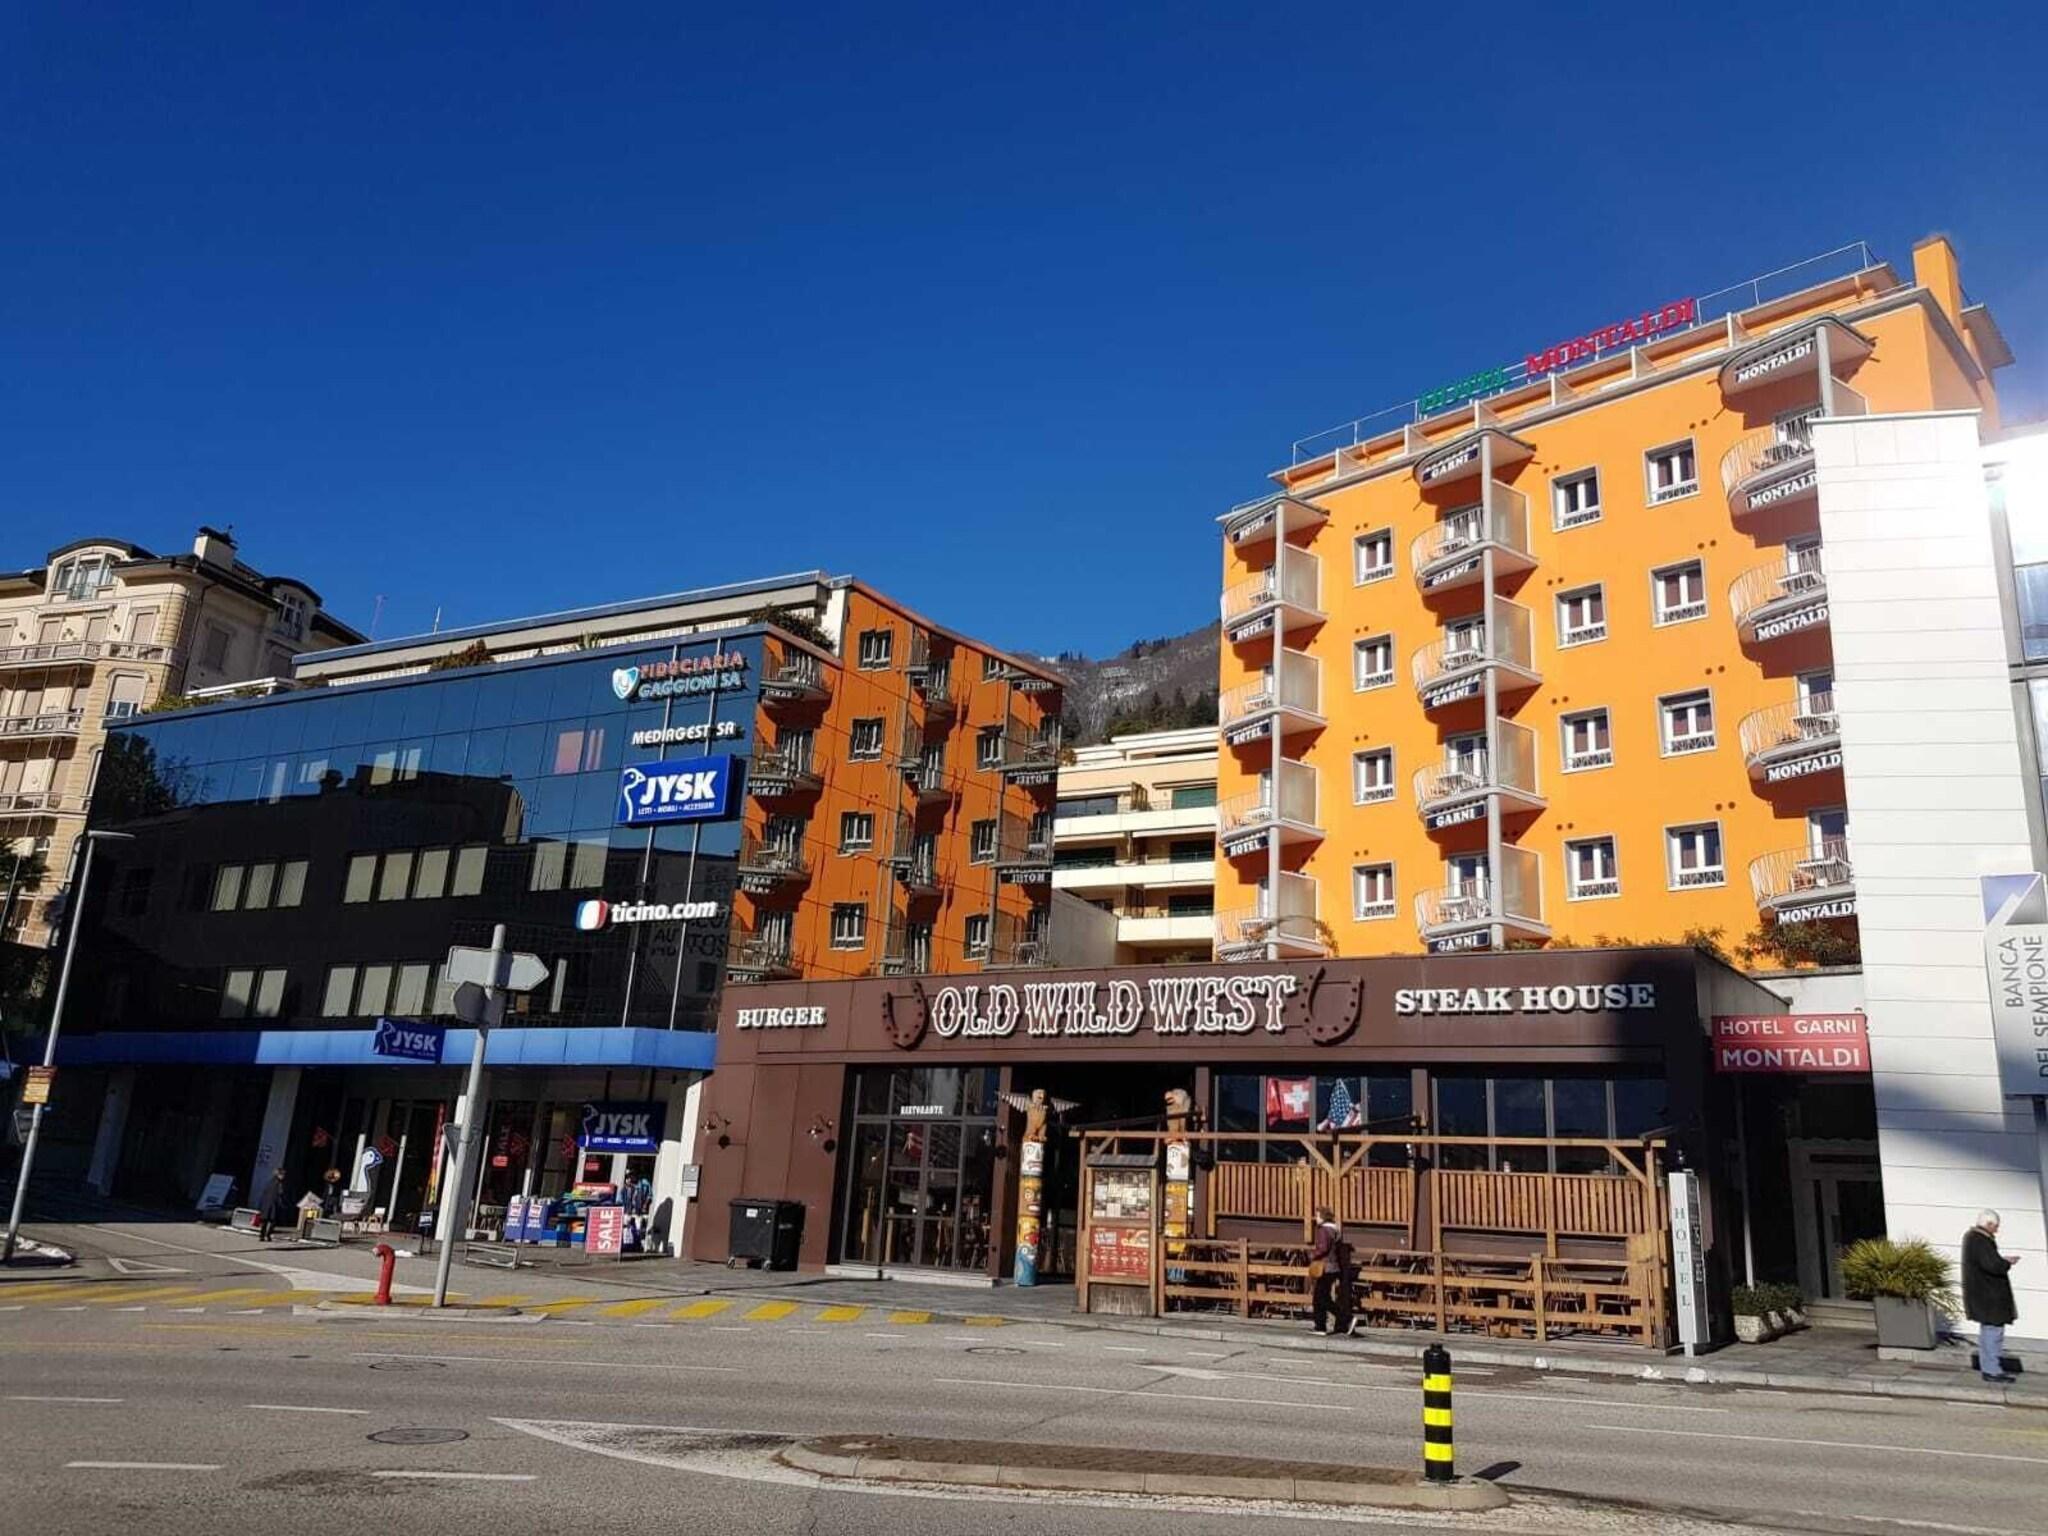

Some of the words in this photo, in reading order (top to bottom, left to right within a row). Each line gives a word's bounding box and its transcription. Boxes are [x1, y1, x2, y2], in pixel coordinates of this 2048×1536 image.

[1525, 297, 1695, 377] MONTALDI
[1738, 342, 1812, 383] MONTALDI
[1430, 453, 1469, 479] GARNI
[1750, 472, 1817, 509] MONTALD
[1239, 517, 1266, 538] HOTEL
[1432, 562, 1470, 586] GARNI
[1237, 620, 1266, 642] HOTEL
[1757, 606, 1828, 640] MONTALD
[638, 675, 717, 698] GAGGIONI
[720, 671, 741, 687] SA
[1433, 685, 1470, 708] GARNI
[716, 721, 736, 736] SA
[1233, 724, 1262, 745] HOTEL
[1768, 753, 1842, 784] MONTALD
[640, 771, 717, 805] JYSK
[1436, 808, 1475, 828] GARNI
[1230, 840, 1260, 859] HOTEL
[611, 899, 718, 923] ticino.com
[1778, 900, 1857, 926] MONTALD
[1438, 934, 1477, 951] GARNI
[1999, 937, 2024, 1008] BANCA
[1395, 988, 1513, 1013] STEAK
[1520, 984, 1656, 1011] HOUSE
[2023, 935, 2048, 1037] SEMPIONE
[736, 1007, 826, 1028] BURGER
[932, 984, 1020, 1038] OLD
[1024, 980, 1143, 1036] WILD
[1149, 974, 1297, 1034] WEST
[1720, 1020, 1784, 1035] HOTEL
[1794, 1019, 1857, 1034] GARNI
[392, 1031, 437, 1052] JYSK
[1722, 1048, 1860, 1067] MONTALDI
[595, 1114, 651, 1135] JYSK
[597, 1210, 614, 1249] SALE
[1674, 1207, 1691, 1307] HOTEL
